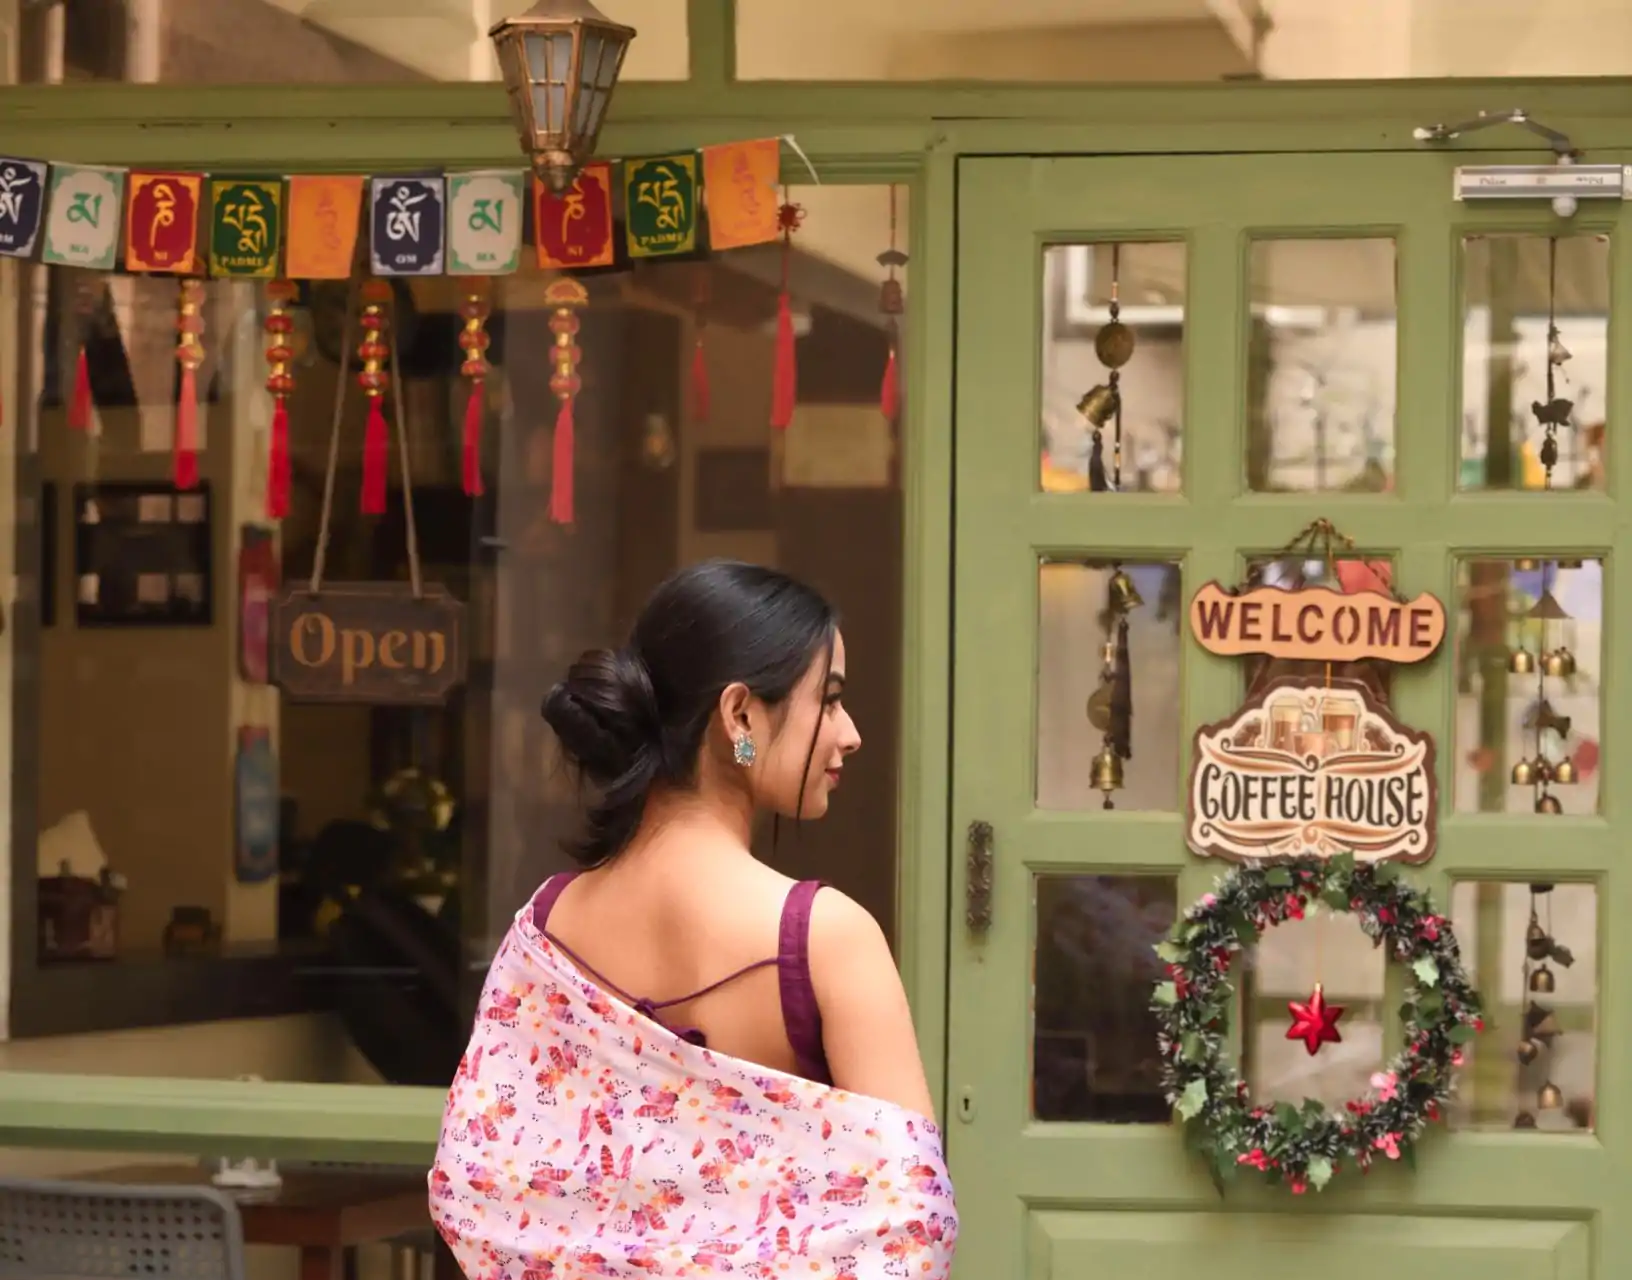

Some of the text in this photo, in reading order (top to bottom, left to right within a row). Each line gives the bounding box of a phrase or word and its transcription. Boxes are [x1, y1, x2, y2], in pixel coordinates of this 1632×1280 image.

[395, 254, 417, 264] OM
[290, 612, 446, 685] Open
[1198, 600, 1433, 648] WELCOME
[1201, 763, 1424, 827] COFFEE HOUSE
